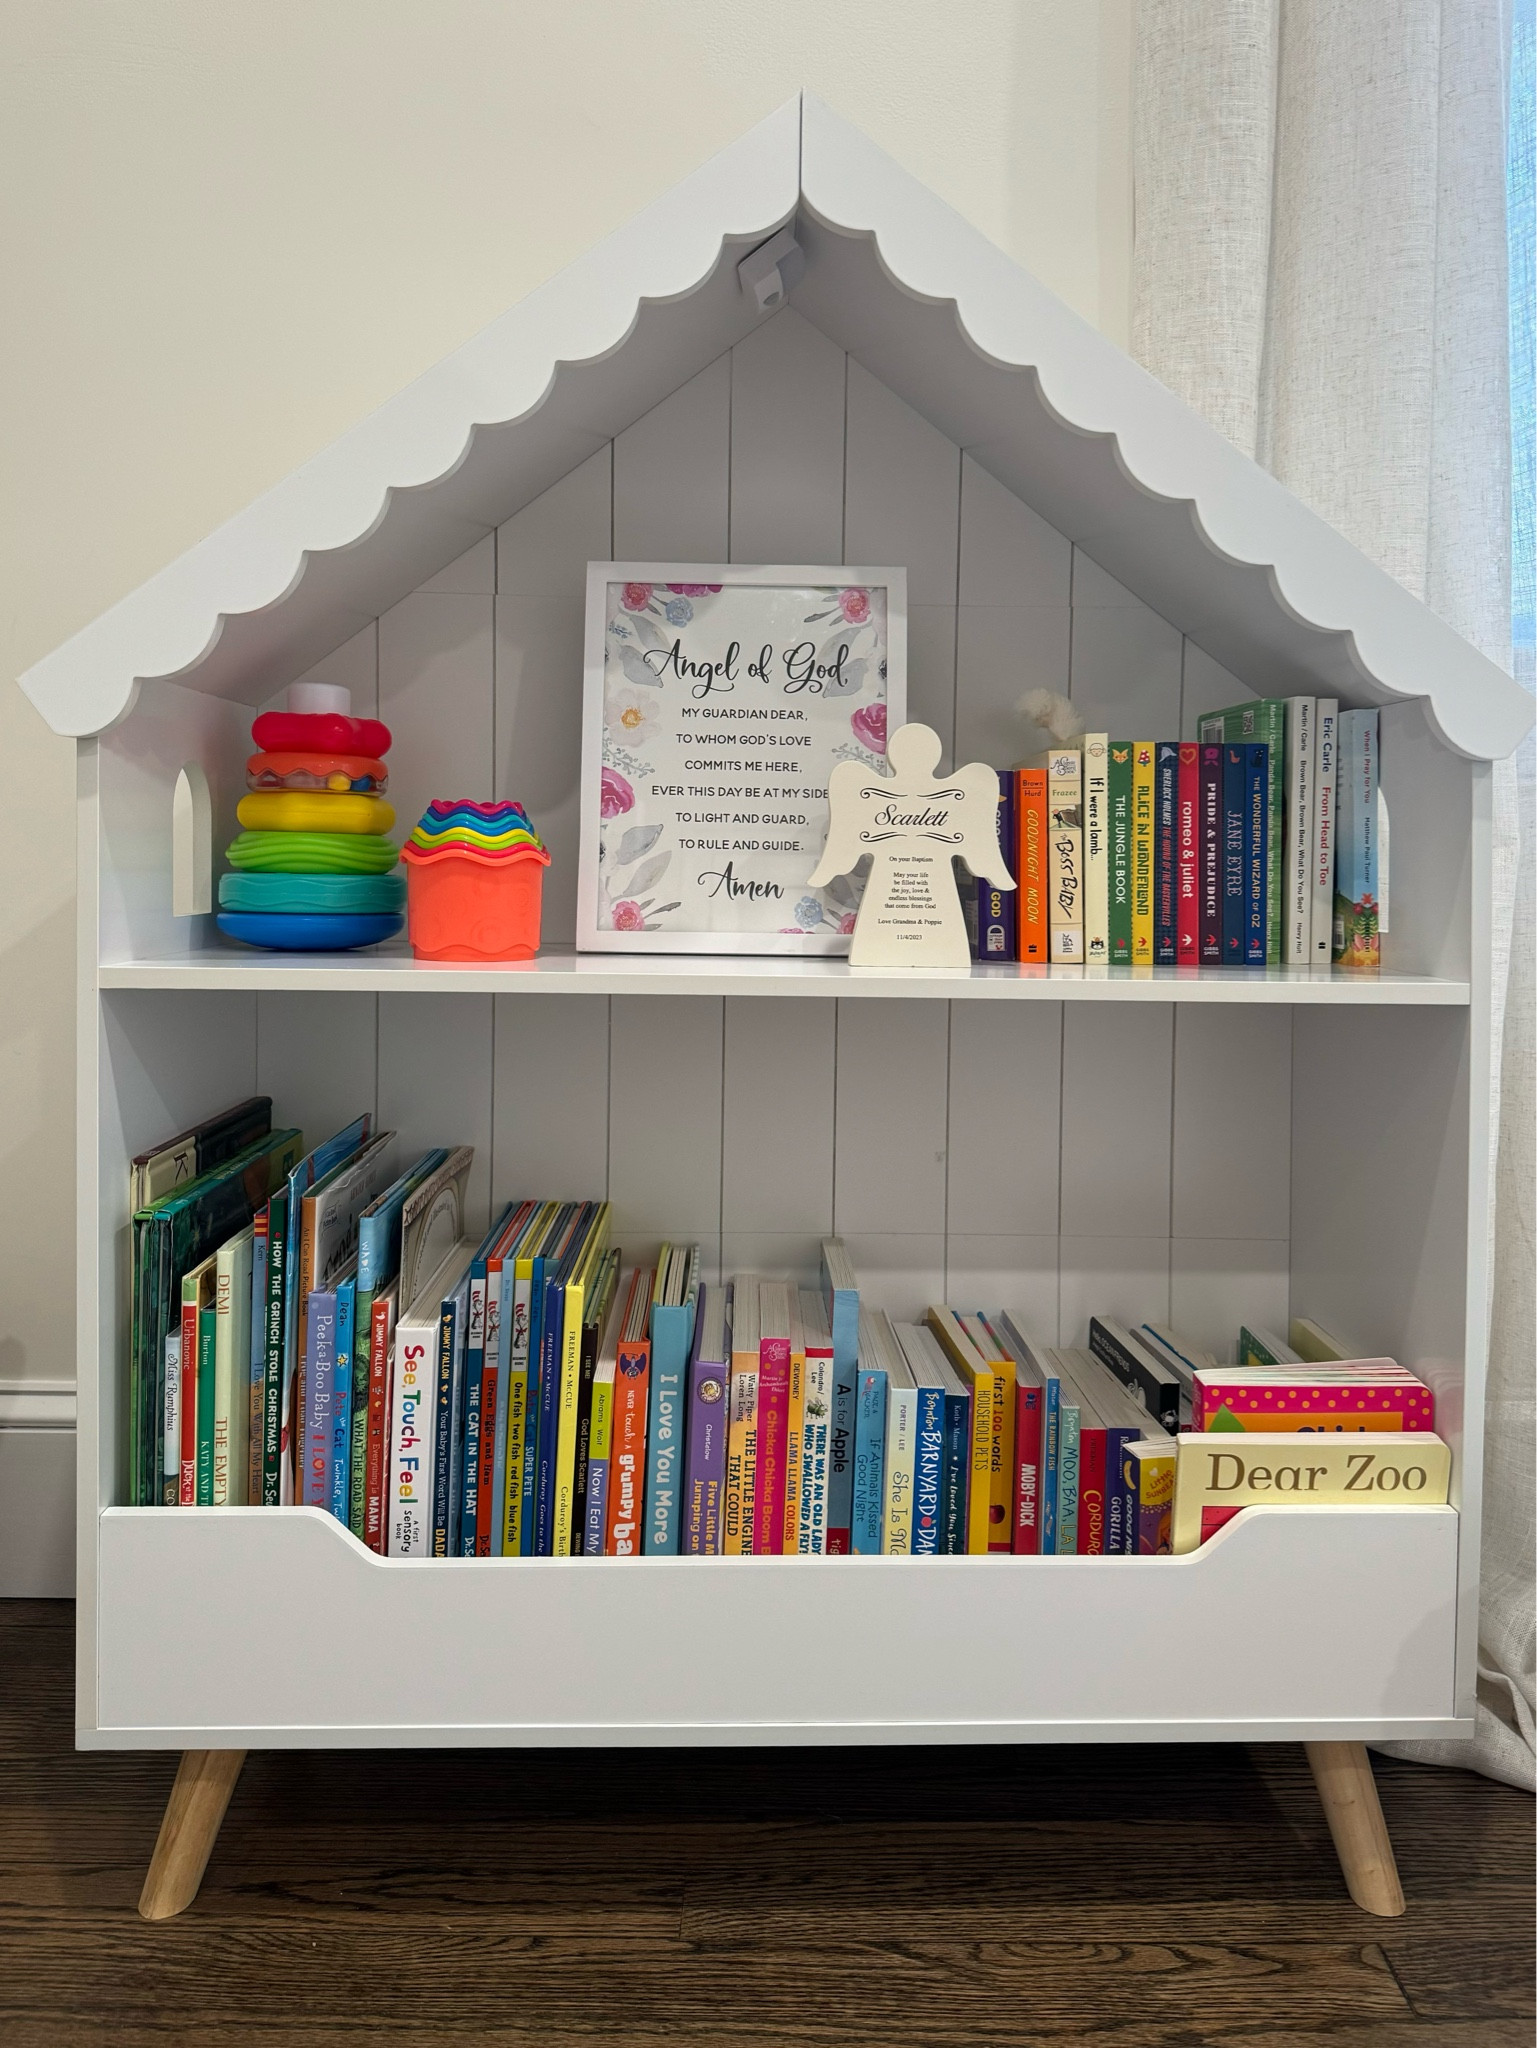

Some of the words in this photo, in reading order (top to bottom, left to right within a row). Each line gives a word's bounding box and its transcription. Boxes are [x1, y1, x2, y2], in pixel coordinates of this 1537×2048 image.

[643, 639, 740, 699] Angel
[747, 644, 772, 683] of
[782, 642, 849, 698] God,
[681, 708, 700, 718] MY
[702, 708, 768, 720] GUARDIAN
[770, 709, 808, 721] DEAR,
[1323, 717, 1333, 739] Eric
[676, 734, 692, 744] TO
[694, 734, 737, 745] WHOM
[780, 736, 812, 746] LOVE
[685, 760, 742, 771] COMMITS
[744, 761, 763, 771] ME
[765, 761, 802, 773] HERE,
[1322, 742, 1333, 772] Carle
[1362, 759, 1371, 777] Pray
[652, 786, 684, 796] EVER
[687, 786, 715, 797] THIS
[718, 786, 743, 797] DAY
[745, 787, 760, 798] BE
[762, 787, 779, 798] AT
[782, 788, 800, 798] MY
[803, 788, 829, 799] SIDE
[1090, 778, 1104, 786] If
[874, 804, 949, 826] Scarlett
[1089, 796, 1098, 819] were
[1115, 795, 1125, 819] THE
[1207, 783, 1216, 825] PRIDE
[1321, 787, 1331, 817] From
[676, 813, 692, 823] TO
[695, 813, 729, 824] LIGHT
[731, 814, 758, 824] AND
[760, 814, 810, 826] GUARD,
[1183, 801, 1193, 845] romeo
[1207, 830, 1216, 838] &
[1226, 810, 1242, 850] JANE
[1252, 793, 1261, 856] WONDERFUL
[1320, 820, 1330, 849] Head
[679, 839, 695, 849] TO
[698, 839, 729, 850] RULE
[731, 840, 758, 850] AND
[761, 840, 804, 851] GUIDE.
[1027, 809, 1039, 882] GOODNIGHT
[1055, 839, 1074, 875] BOSS
[1115, 820, 1125, 866] JUNGLE
[1183, 850, 1194, 859] &
[1320, 853, 1329, 864] to
[698, 861, 784, 901] Amen
[1116, 870, 1126, 904] BOOK
[1180, 861, 1194, 898] juliet
[1207, 843, 1216, 917] PREJUDICE
[1226, 855, 1242, 897] EYRE
[1252, 859, 1261, 899] WIZARD
[1319, 866, 1329, 886] Toe
[990, 892, 1001, 917] GOD
[1027, 887, 1039, 924] MOON
[1058, 877, 1078, 919] BABY
[1252, 903, 1258, 911] OF
[1252, 914, 1260, 928] OZ
[272, 1241, 282, 1268] HOW
[218, 1274, 230, 1315] DEMI
[271, 1275, 281, 1295] THE
[269, 1302, 280, 1344] GRINCH
[374, 1323, 384, 1348] JIMMY
[183, 1318, 195, 1370] Urbanovic
[166, 1354, 178, 1381] Miss
[269, 1350, 279, 1382] STOLE
[374, 1350, 384, 1377] FALLON
[402, 1345, 425, 1388] See,
[660, 1374, 677, 1383] I
[469, 1384, 479, 1407] THE
[792, 1363, 800, 1399] DEWDNEY
[837, 1384, 851, 1395] A
[993, 1376, 1006, 1406] first
[166, 1383, 178, 1431] Rumphius
[659, 1390, 677, 1439] Love
[837, 1410, 847, 1424] for
[838, 1398, 847, 1406] is
[924, 1392, 939, 1430] Boynton
[975, 1390, 990, 1443] HOUSEHOLD
[266, 1389, 278, 1453] CHRISTMAS
[398, 1389, 421, 1452] Touch,
[468, 1412, 479, 1437] CAT
[993, 1411, 1003, 1431] 100
[468, 1442, 477, 1455] IN
[788, 1432, 798, 1465] LLAMA
[833, 1427, 850, 1473] Apple
[991, 1436, 1002, 1473] words
[1048, 1425, 1056, 1455] RAINBOW
[467, 1461, 477, 1484] THE
[656, 1445, 675, 1484] You
[919, 1431, 941, 1515] BARNYARD
[975, 1447, 989, 1471] PETS
[1205, 1453, 1327, 1491] Dear
[1343, 1454, 1427, 1491] Zoo
[399, 1457, 419, 1504] Feel
[787, 1468, 797, 1501] LLAMA
[1020, 1464, 1036, 1527] MOBY-DICK
[465, 1489, 477, 1516] HAT
[654, 1491, 672, 1544] More
[401, 1510, 413, 1552] sensory
[786, 1505, 796, 1541] COLORS
[1109, 1496, 1121, 1549] GORILLA
